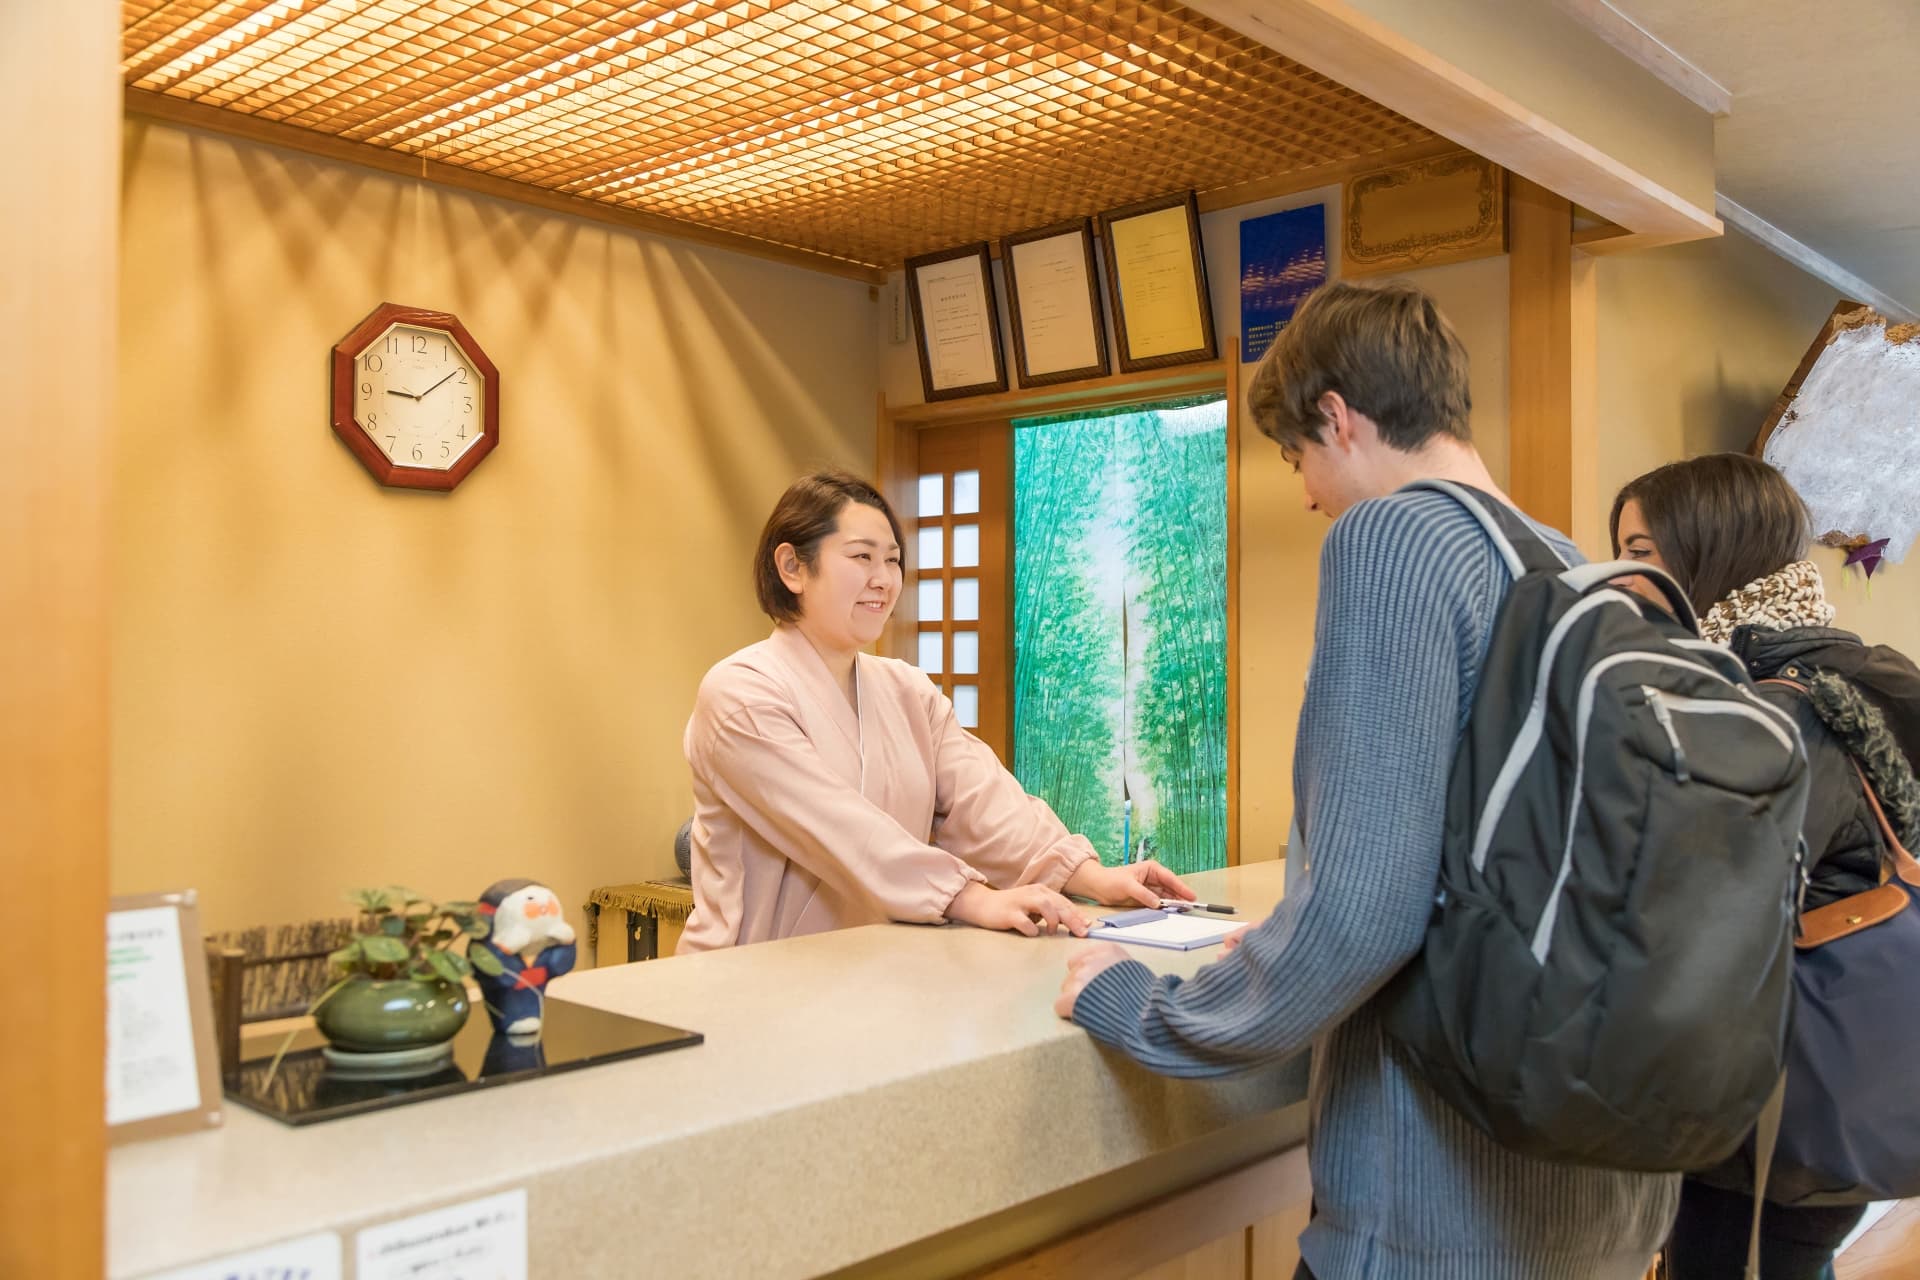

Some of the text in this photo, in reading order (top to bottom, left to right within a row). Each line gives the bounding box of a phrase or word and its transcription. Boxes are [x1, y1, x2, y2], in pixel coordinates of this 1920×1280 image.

[386, 336, 398, 354] 11
[412, 336, 427, 354] 12
[444, 345, 447, 361] 1
[364, 354, 382, 372] 10
[456, 367, 468, 384] 2
[362, 382, 372, 400] 9
[464, 396, 472, 414] 3
[368, 413, 376, 430] 8
[456, 424, 467, 440] 4
[386, 436, 396, 452] 7
[412, 444, 422, 461] 6
[440, 441, 450, 458] 5
